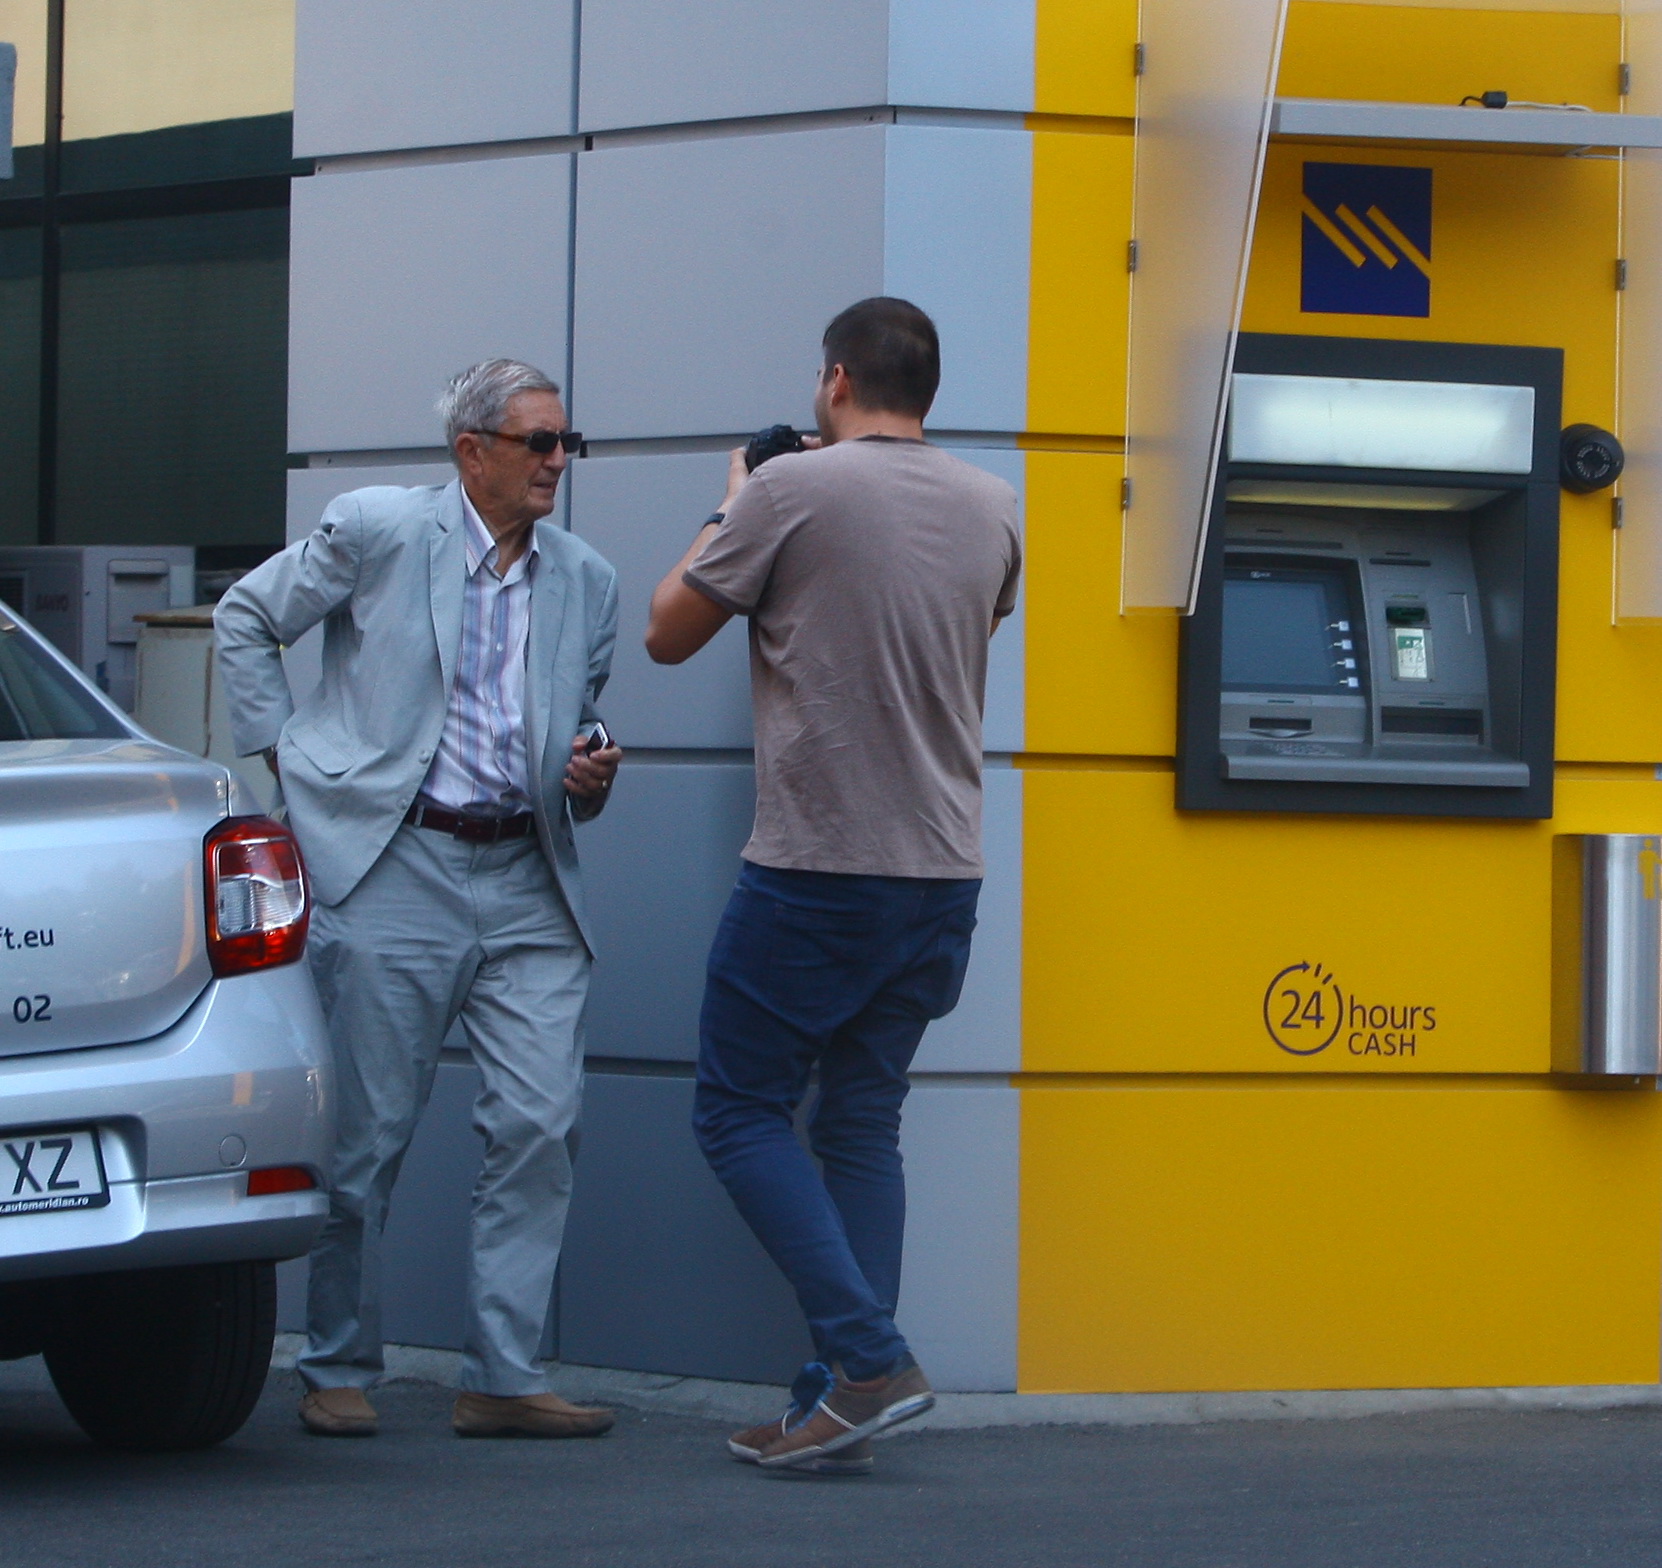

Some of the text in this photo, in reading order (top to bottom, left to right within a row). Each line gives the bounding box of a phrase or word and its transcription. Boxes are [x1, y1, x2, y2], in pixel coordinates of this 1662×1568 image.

[13, 994, 52, 1024] 02
[1280, 989, 1436, 1031] 24 hours
[1347, 1032, 1416, 1057] CASH
[4, 1138, 80, 1195] XZ
